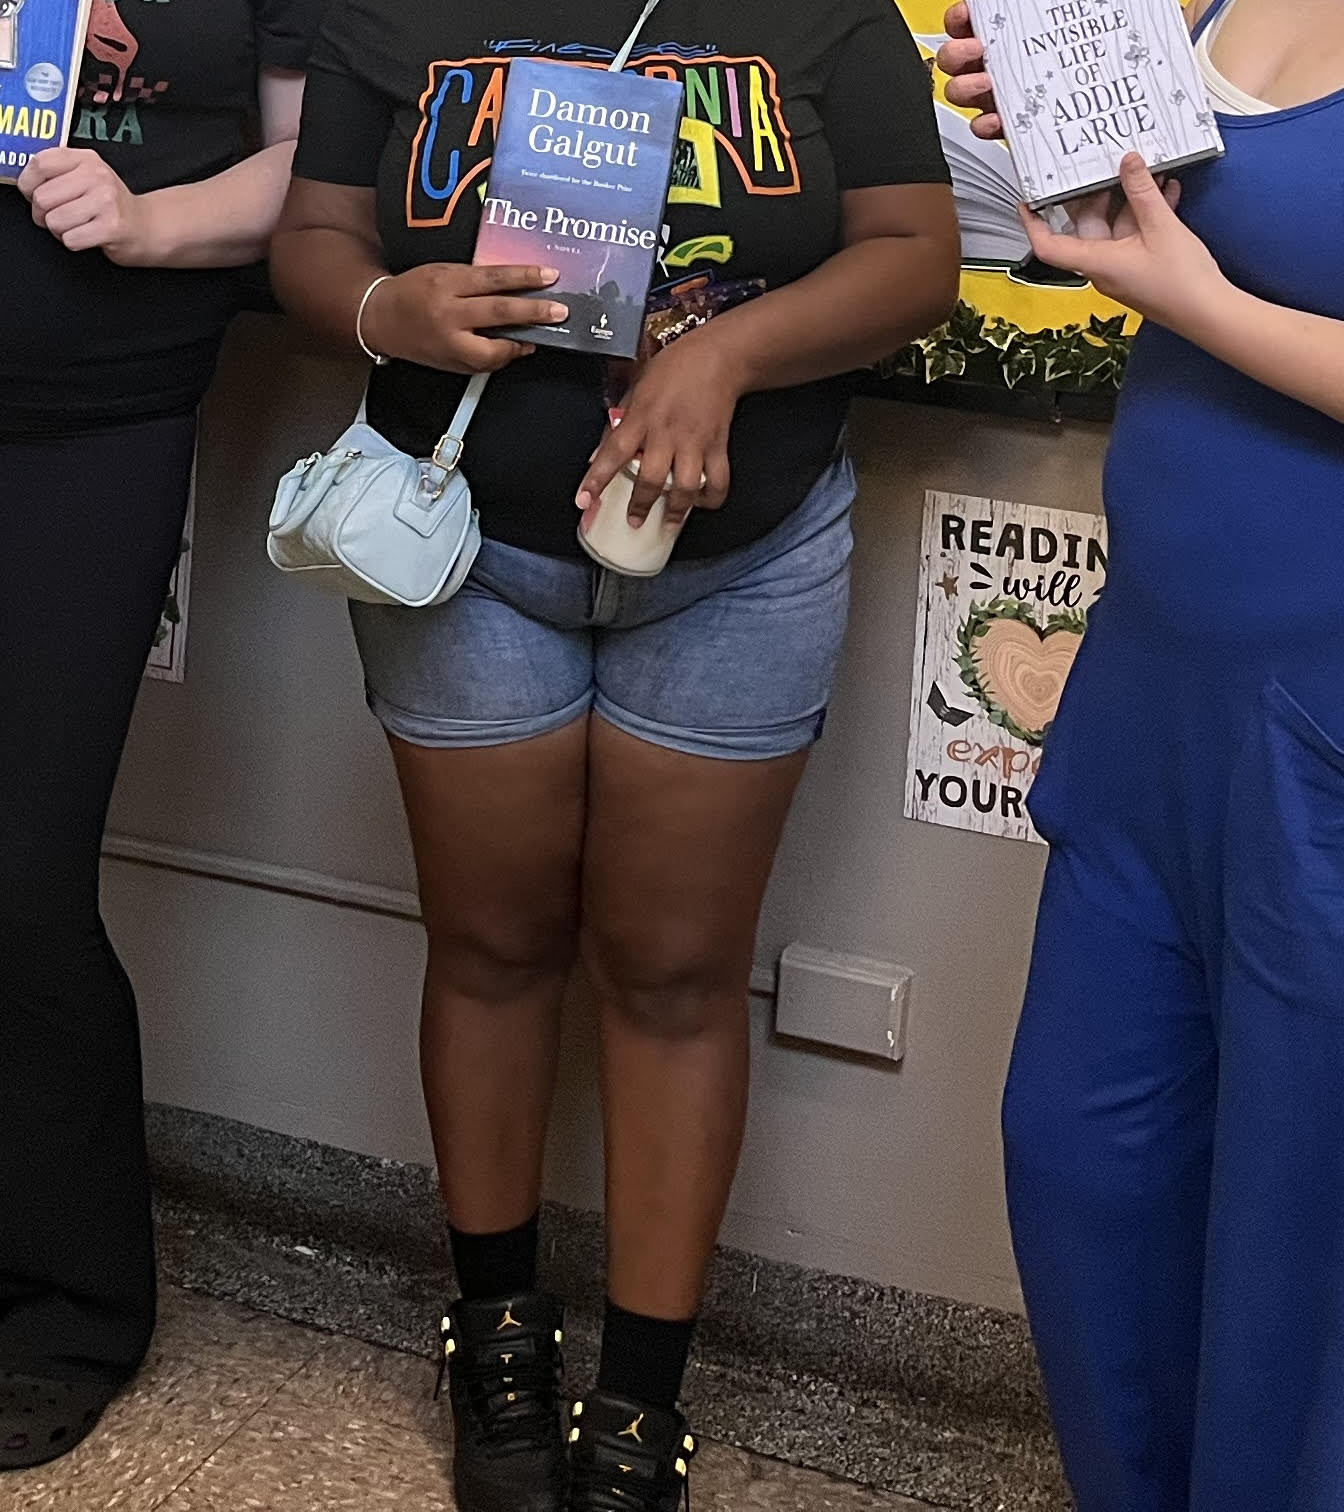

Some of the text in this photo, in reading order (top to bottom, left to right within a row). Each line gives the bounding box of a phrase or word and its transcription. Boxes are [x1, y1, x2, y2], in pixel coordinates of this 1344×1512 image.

[1022, 9, 1129, 57] INVISIBLE
[1057, 39, 1106, 69] LIFE
[1074, 62, 1100, 86] OF
[528, 88, 651, 134] Damon
[1053, 74, 1146, 126] ADDIE
[528, 124, 639, 169] Galgut
[484, 197, 657, 249] The Promise
[941, 514, 1109, 573] READIN
[1002, 570, 1083, 608] will
[946, 737, 1042, 782] exp
[915, 769, 1025, 818] YOUR
